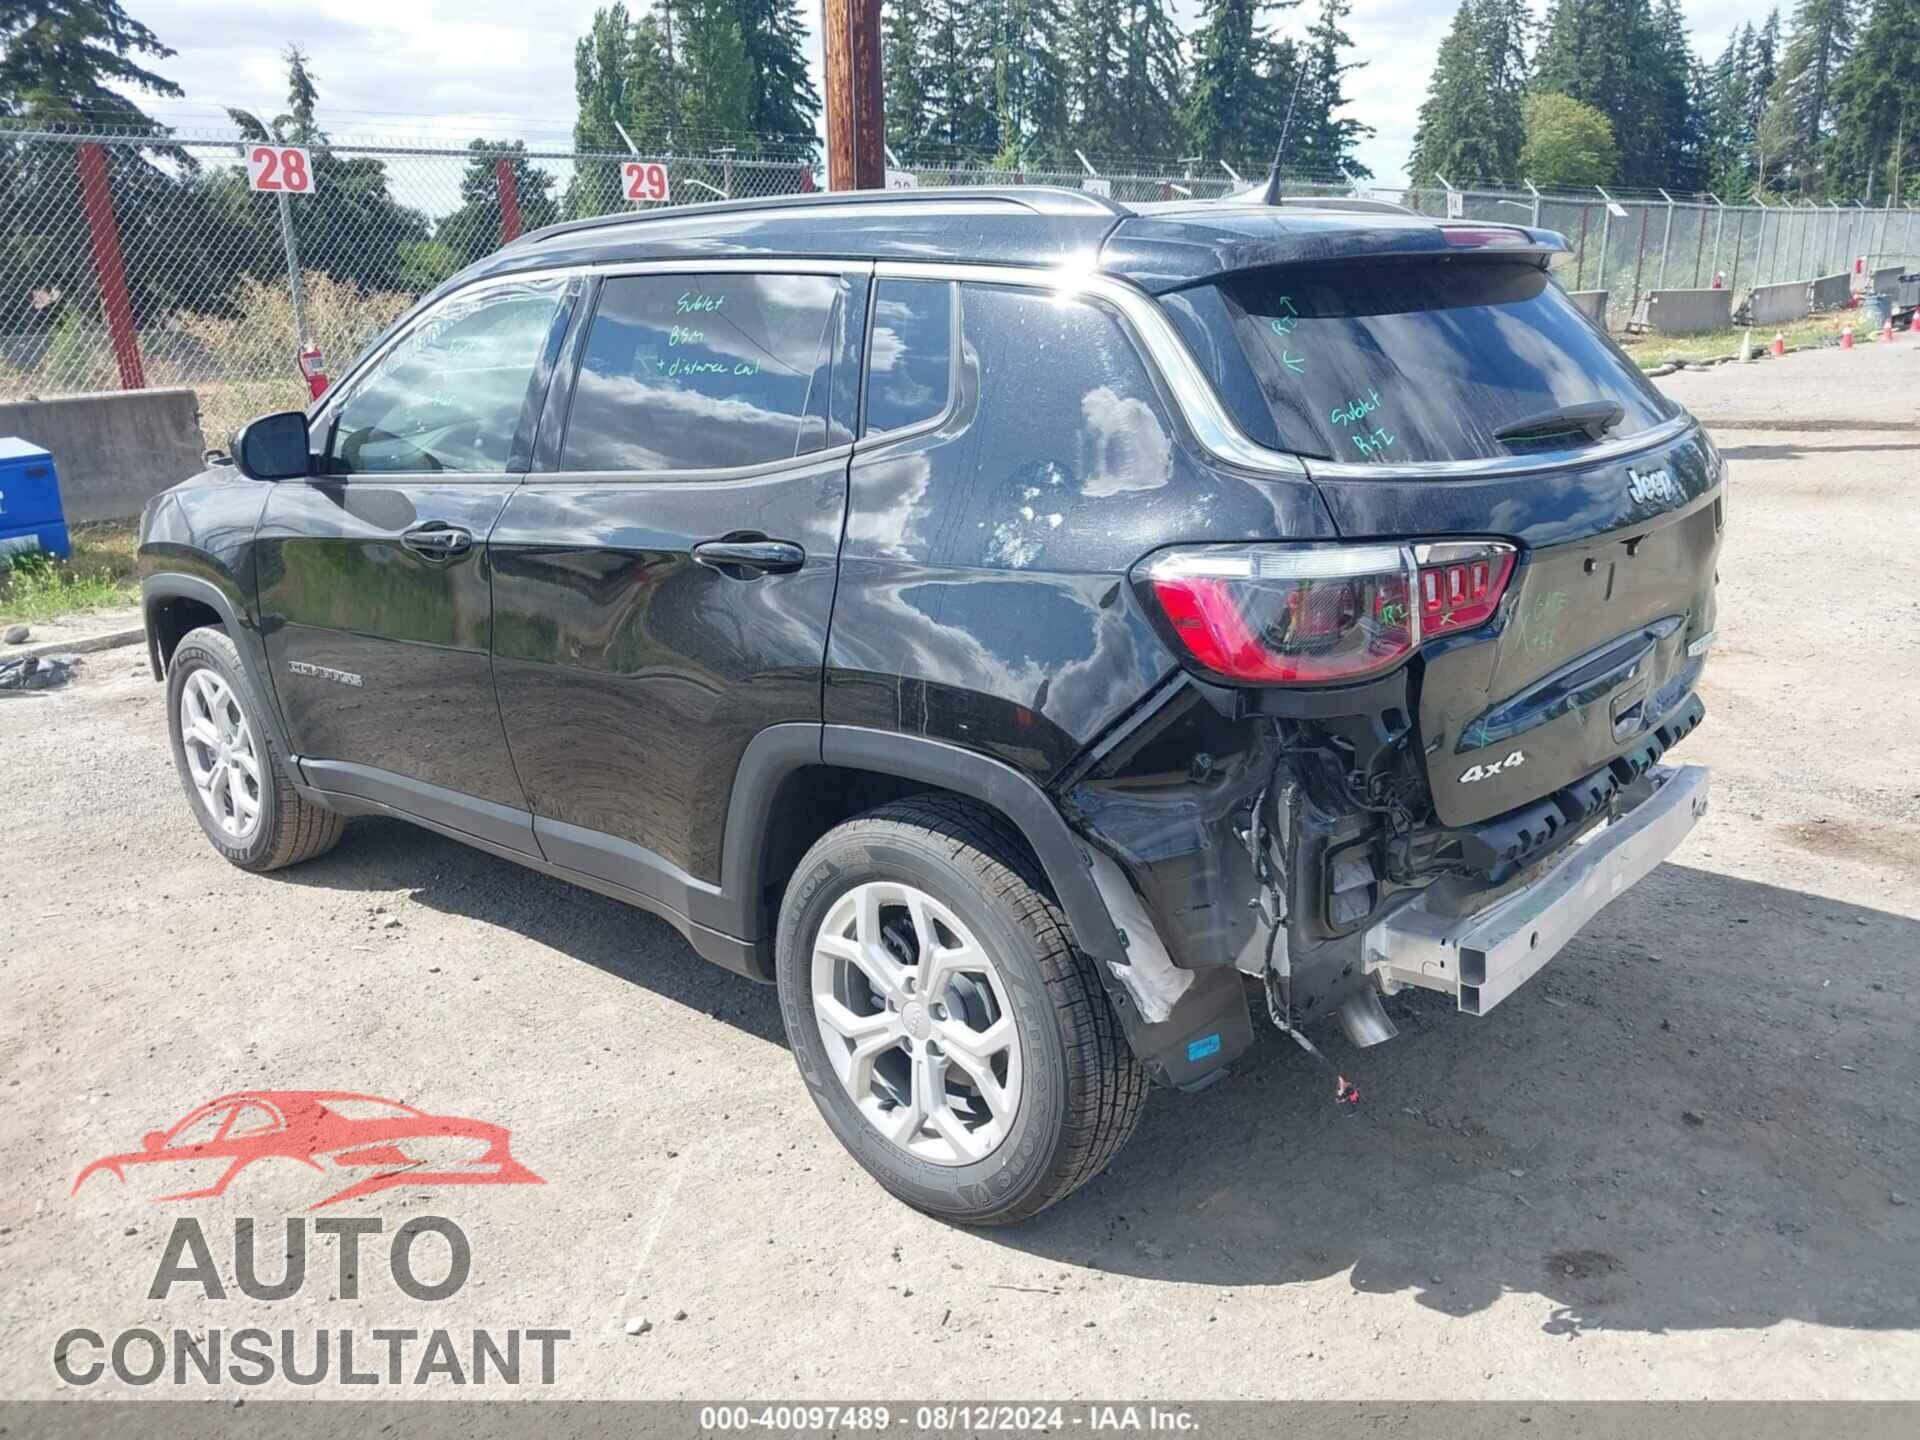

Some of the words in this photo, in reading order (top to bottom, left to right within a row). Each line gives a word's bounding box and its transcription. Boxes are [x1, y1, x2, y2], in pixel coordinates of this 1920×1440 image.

[252, 147, 308, 191] 28
[626, 164, 665, 199] 29
[675, 292, 724, 315] Sublet
[1331, 388, 1381, 426] Sublet
[1627, 469, 1672, 505] Jeep
[1458, 750, 1526, 783] 4x4
